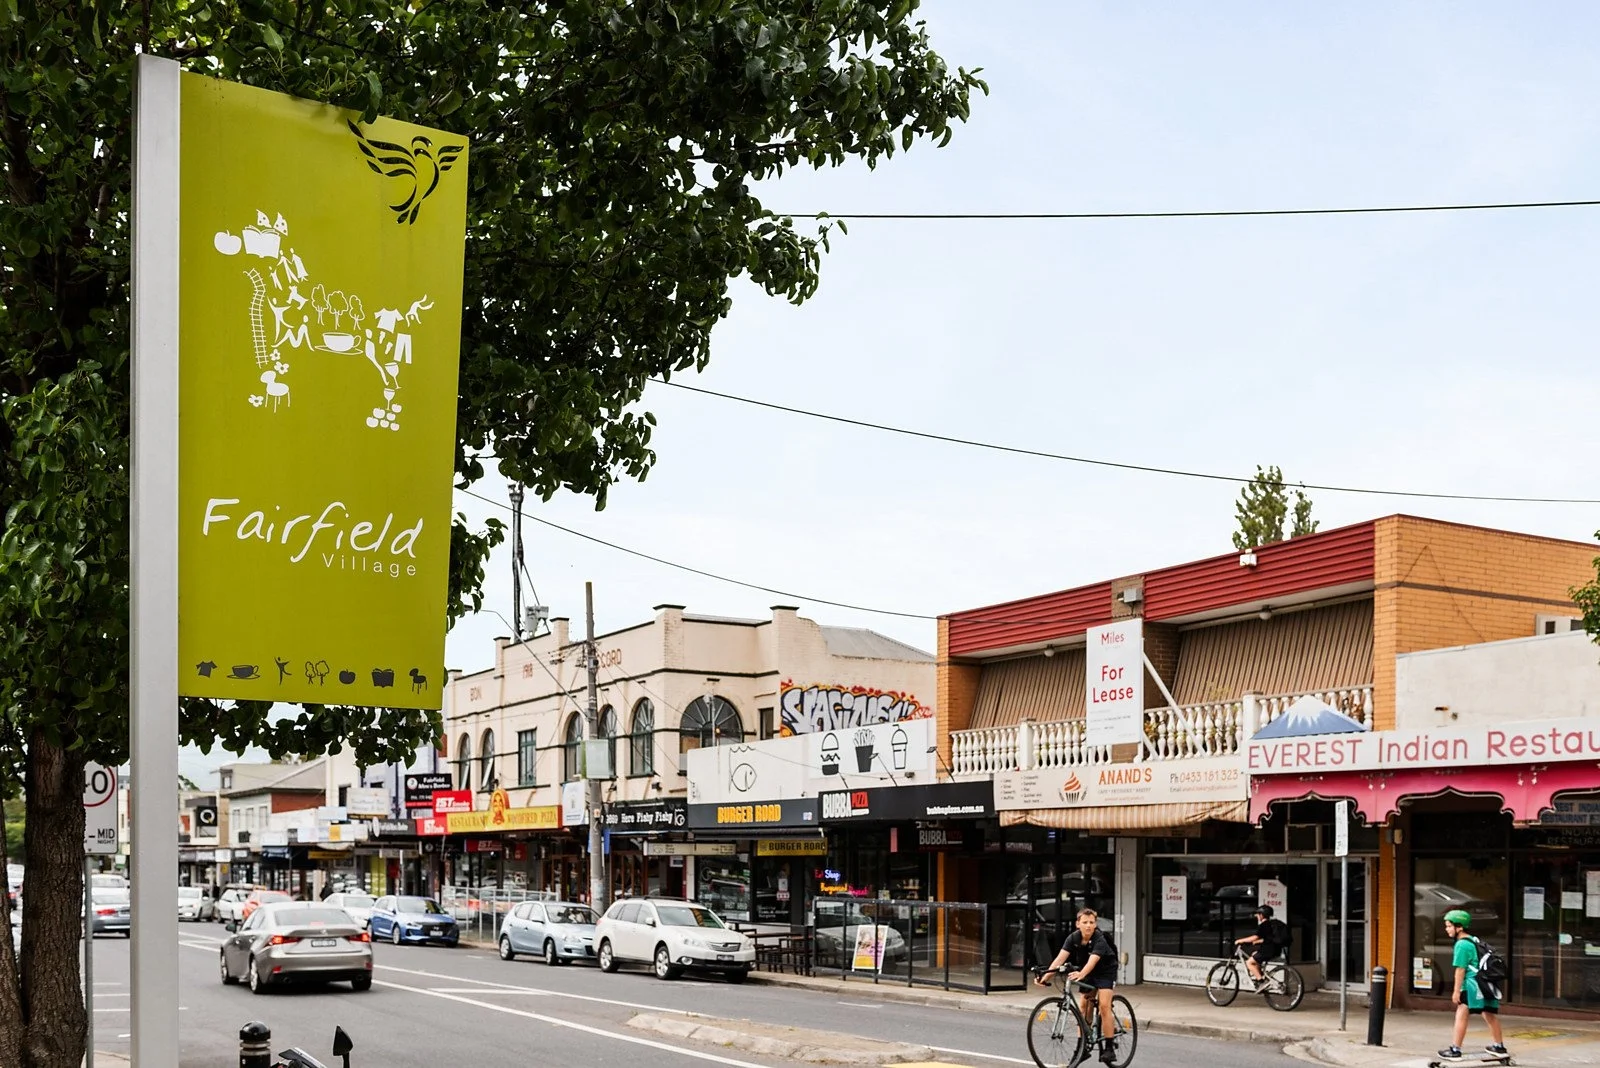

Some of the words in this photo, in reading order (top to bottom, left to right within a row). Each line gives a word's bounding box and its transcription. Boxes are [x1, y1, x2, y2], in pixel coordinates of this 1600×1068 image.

[202, 498, 424, 563] Fairfield
[322, 553, 417, 578] Village
[1101, 631, 1125, 645] Miles
[1101, 665, 1124, 682] For
[1092, 686, 1134, 703] Lease
[1248, 739, 1363, 769] EVEREST
[1378, 735, 1468, 763] Indian
[1486, 727, 1600, 759] Restau
[1098, 767, 1153, 785] ANAND'S
[822, 792, 852, 819] BUBBA
[636, 811, 654, 825] Fishy
[655, 810, 673, 825] Fishy
[717, 805, 754, 824] BURGER
[755, 804, 781, 822] ROAD
[97, 828, 115, 839] MID
[919, 830, 948, 845] BUBBA
[768, 842, 803, 851] BURGER
[803, 841, 826, 851] ROAD
[1166, 893, 1183, 901] Lease
[1169, 886, 1179, 894] For
[1267, 890, 1278, 898] For
[1263, 898, 1282, 906] Lease
